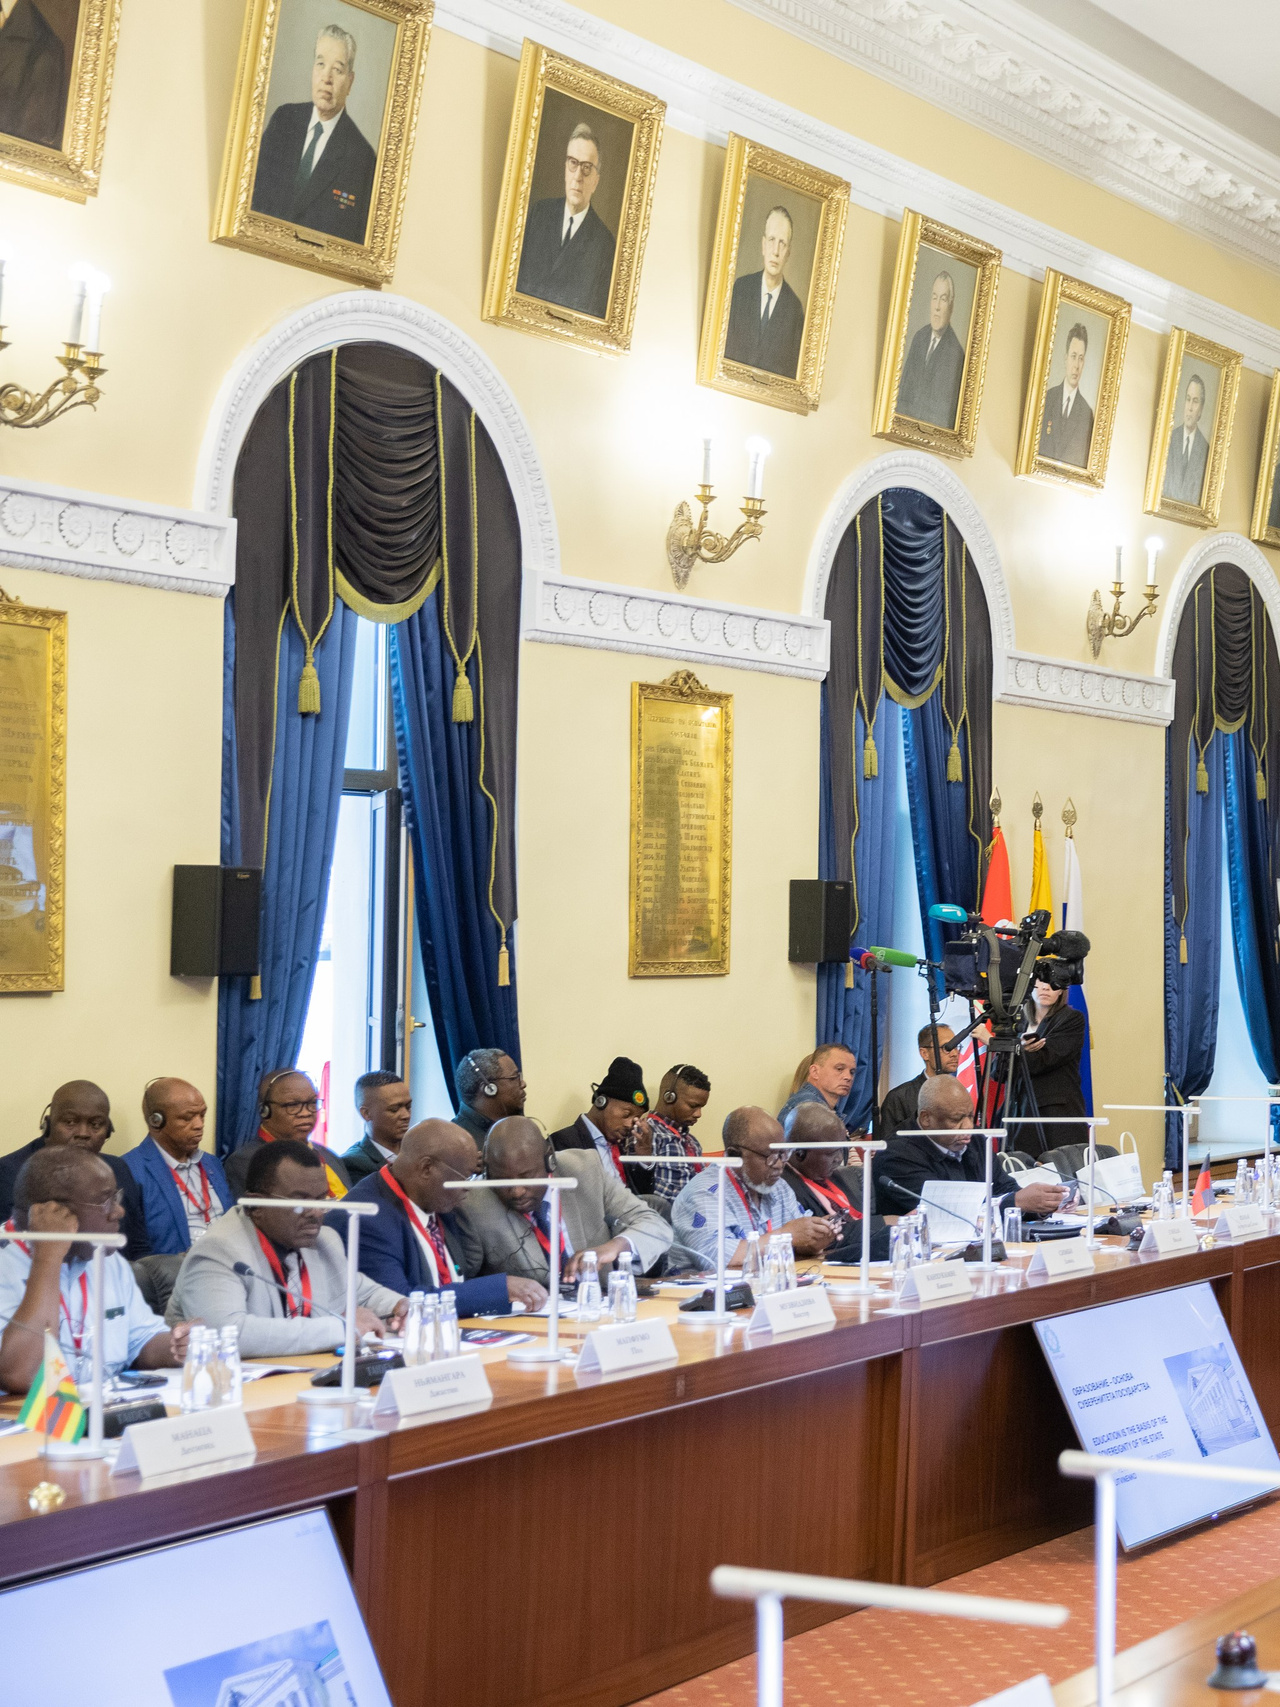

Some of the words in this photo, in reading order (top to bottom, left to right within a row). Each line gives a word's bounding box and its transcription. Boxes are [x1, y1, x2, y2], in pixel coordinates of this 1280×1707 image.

[1072, 1378, 1110, 1396] ОБРАЗОВАНИЕ
[1112, 1372, 1135, 1385] ОСНОВА
[1078, 1392, 1116, 1410] СУВЕРЕНИТЕТА
[1115, 1382, 1151, 1398] ГОСУДАРСТВА
[1092, 1430, 1121, 1446] EDUCATION
[1126, 1425, 1137, 1435] THE
[1136, 1420, 1151, 1432] BASIS
[1157, 1415, 1168, 1425] THE
[1139, 1436, 1150, 1445] THE
[1149, 1431, 1165, 1442] STATE
